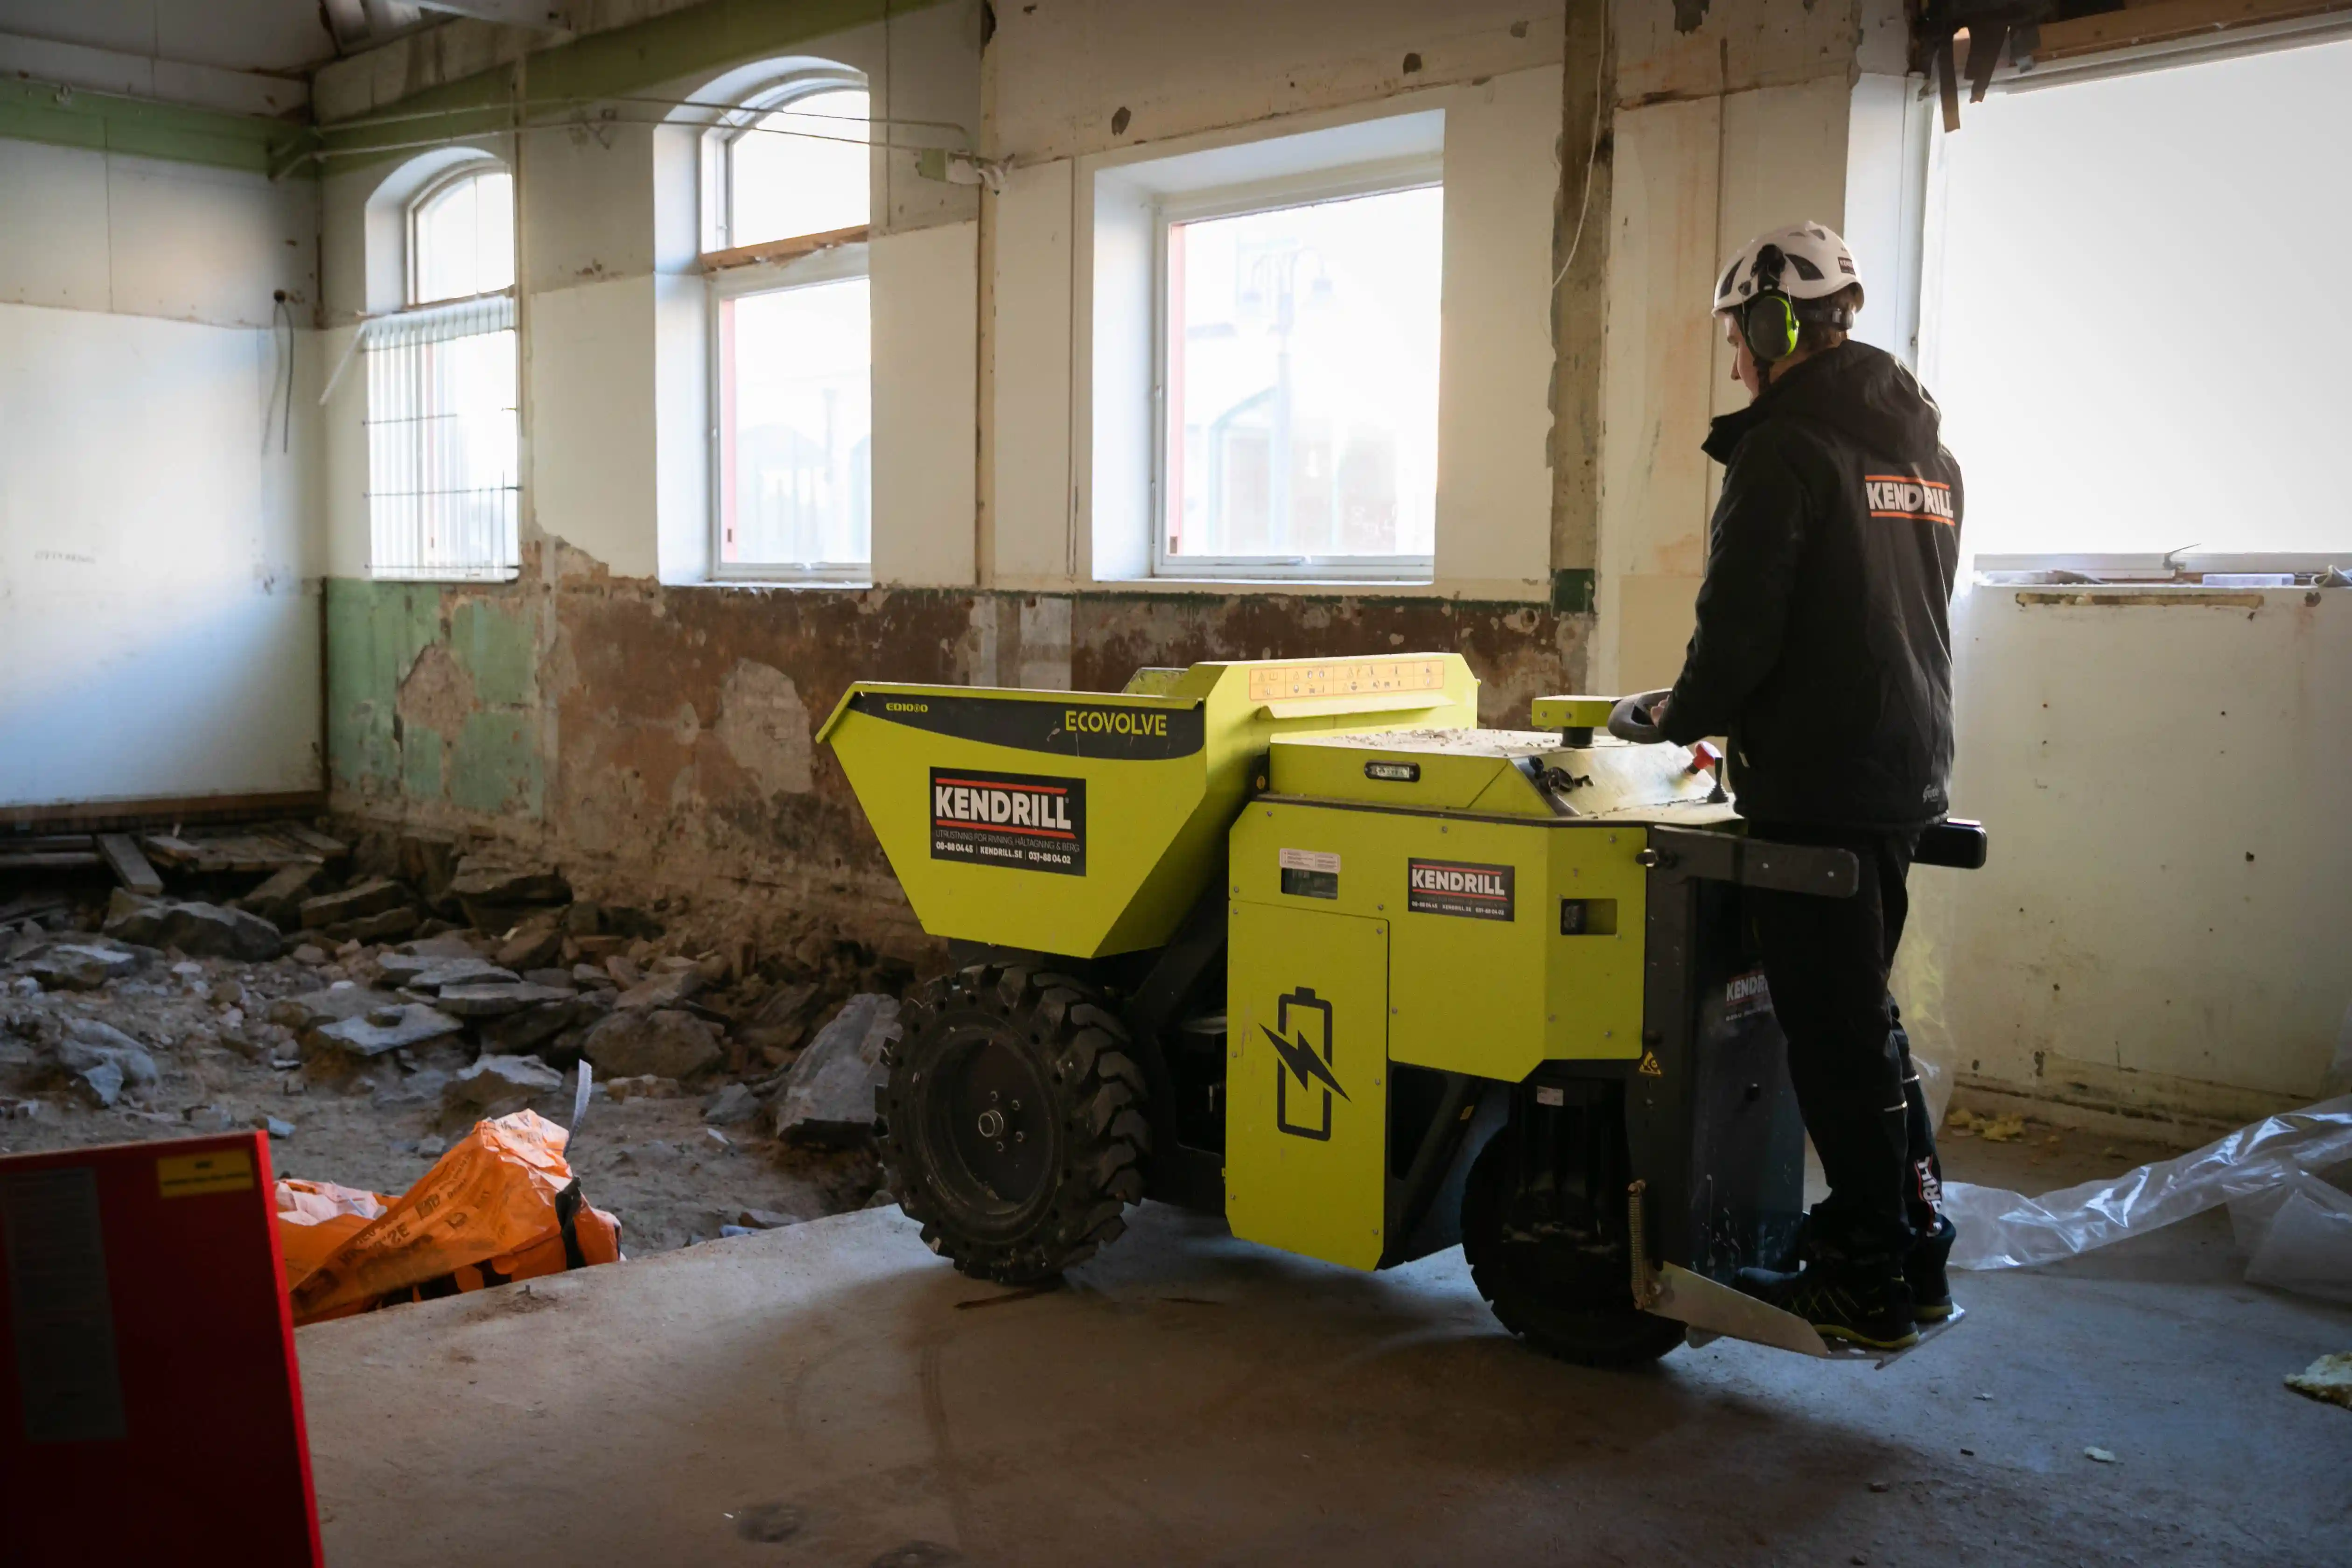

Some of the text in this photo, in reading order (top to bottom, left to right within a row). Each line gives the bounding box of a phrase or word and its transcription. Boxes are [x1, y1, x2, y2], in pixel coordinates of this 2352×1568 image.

[1866, 482, 1953, 518] KENDRILL
[1065, 710, 1167, 736] ECOVOLVE
[935, 785, 1071, 830] KENDRILL
[980, 846, 1023, 859] KENDRILL.SE
[1056, 841, 1061, 850] &
[1412, 868, 1505, 896] KENDRILL
